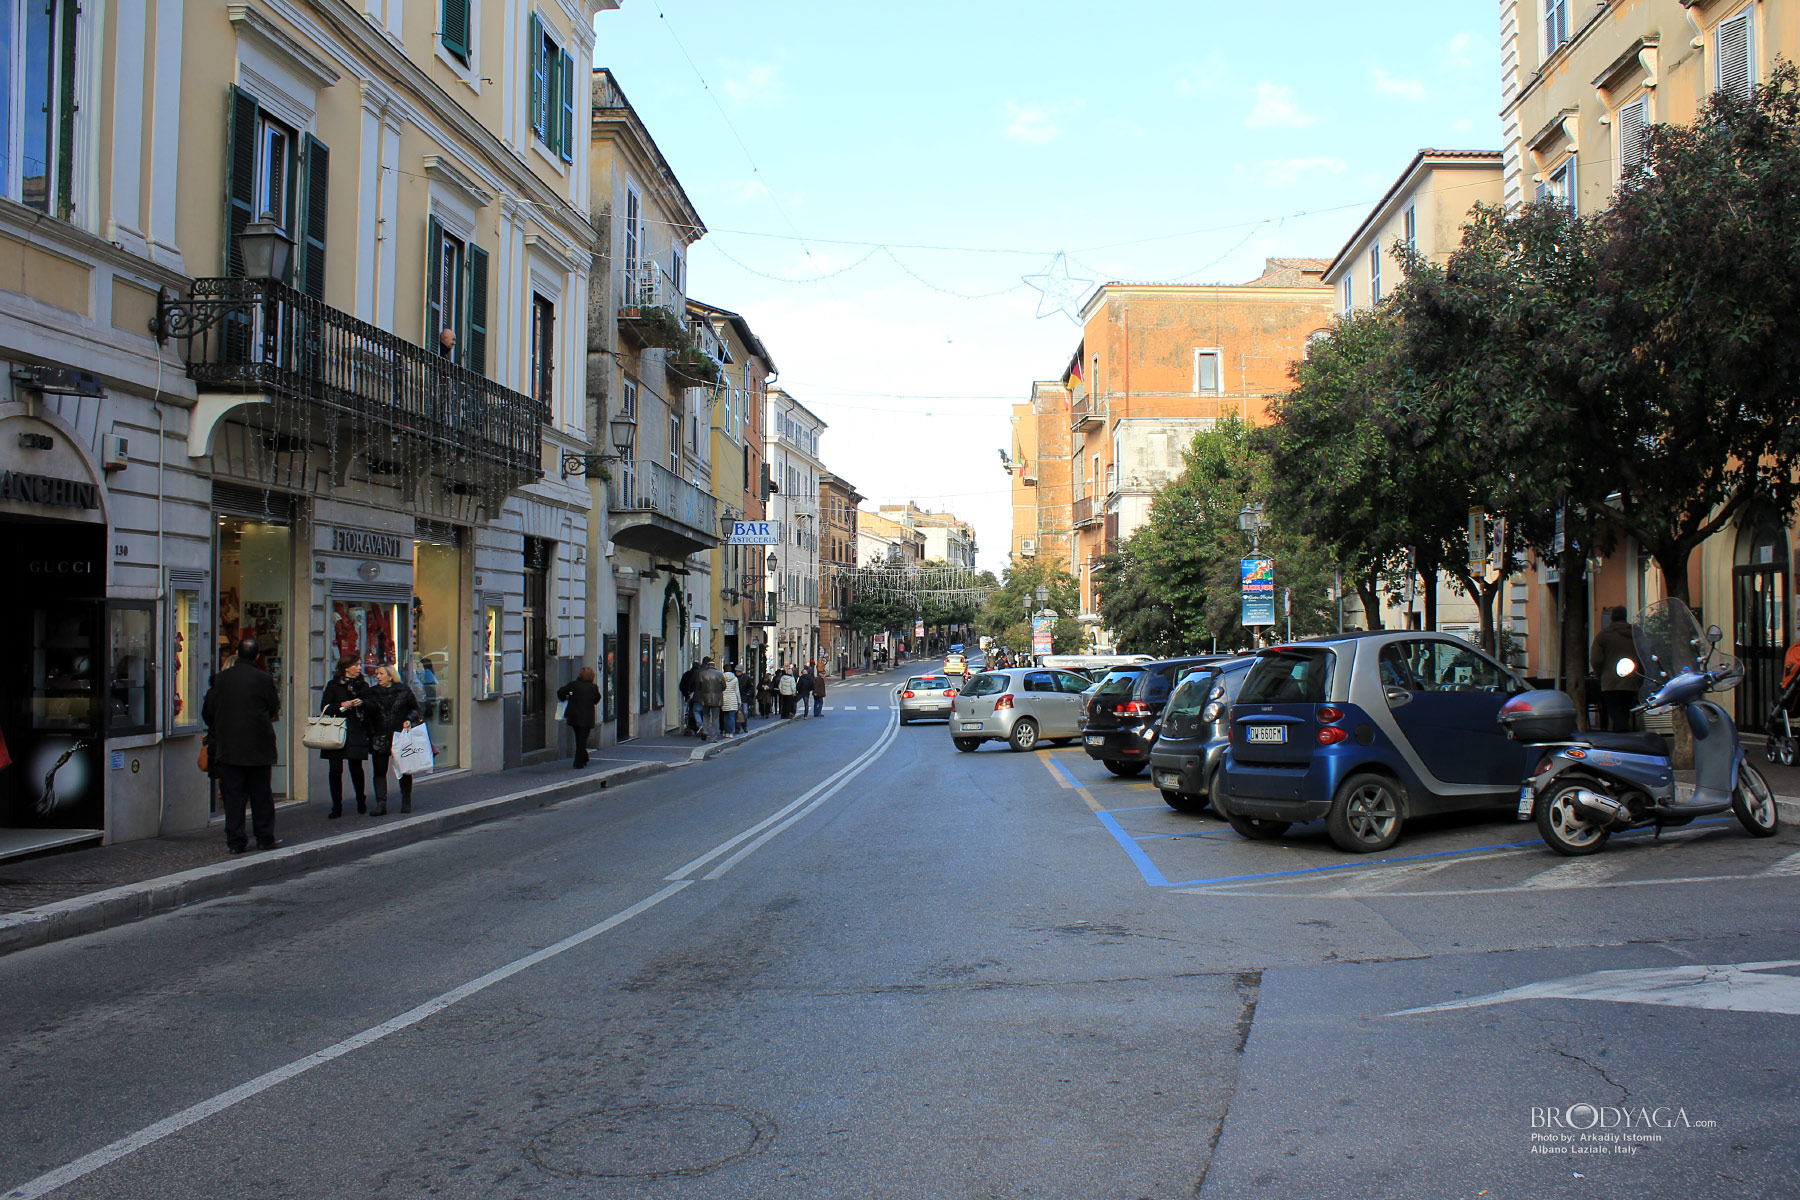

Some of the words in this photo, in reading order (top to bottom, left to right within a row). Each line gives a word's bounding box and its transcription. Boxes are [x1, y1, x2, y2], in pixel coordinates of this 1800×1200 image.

[734, 522, 770, 536] BAR
[728, 536, 777, 544] PASTICCERIA
[115, 545, 129, 556] 130
[29, 561, 91, 574] GUCCI
